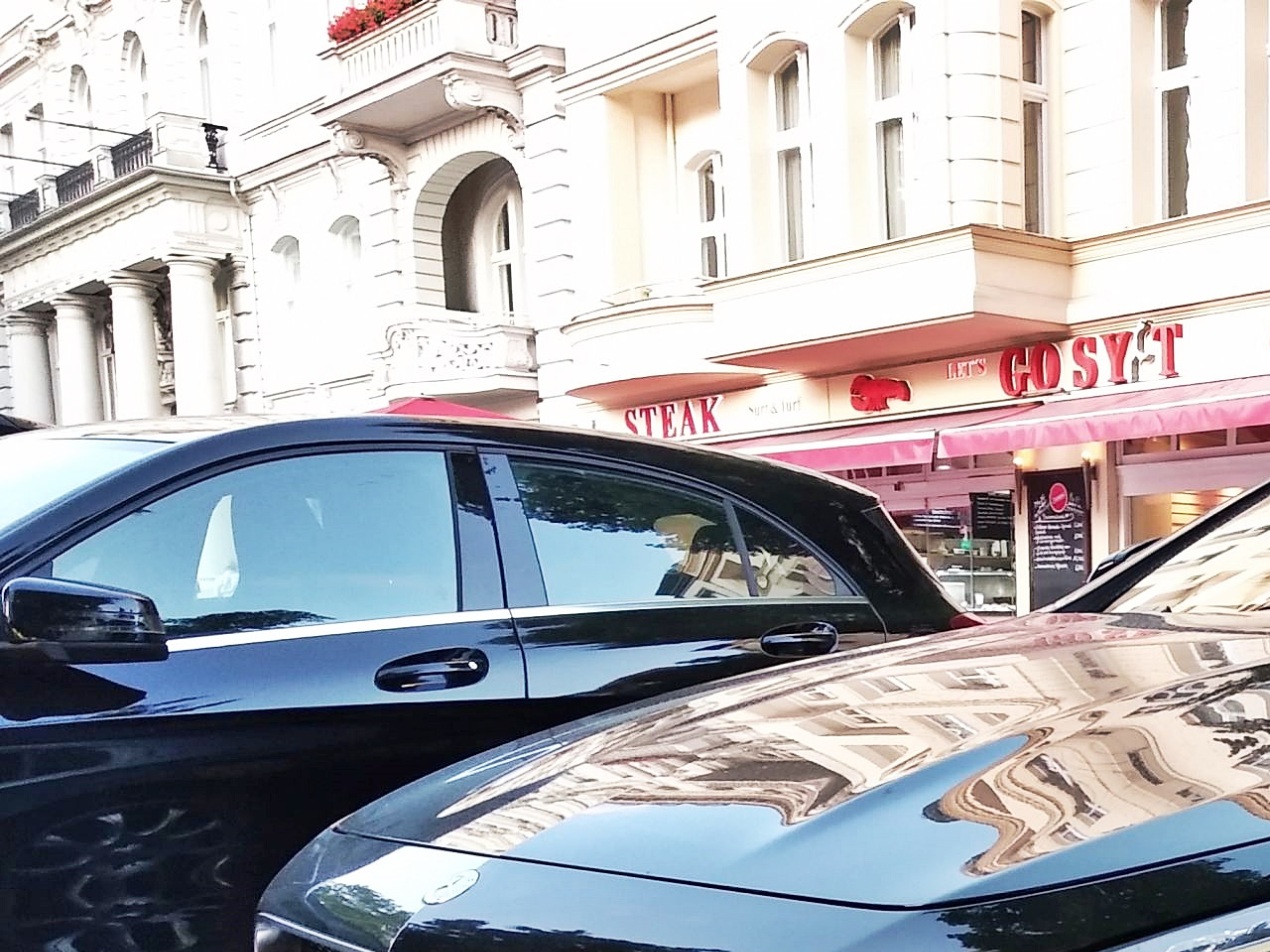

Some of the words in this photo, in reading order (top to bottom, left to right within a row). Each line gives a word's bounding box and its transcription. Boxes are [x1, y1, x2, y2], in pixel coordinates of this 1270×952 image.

[944, 358, 988, 380] LET'S
[999, 341, 1062, 398] GO
[624, 394, 724, 439] STEAK
